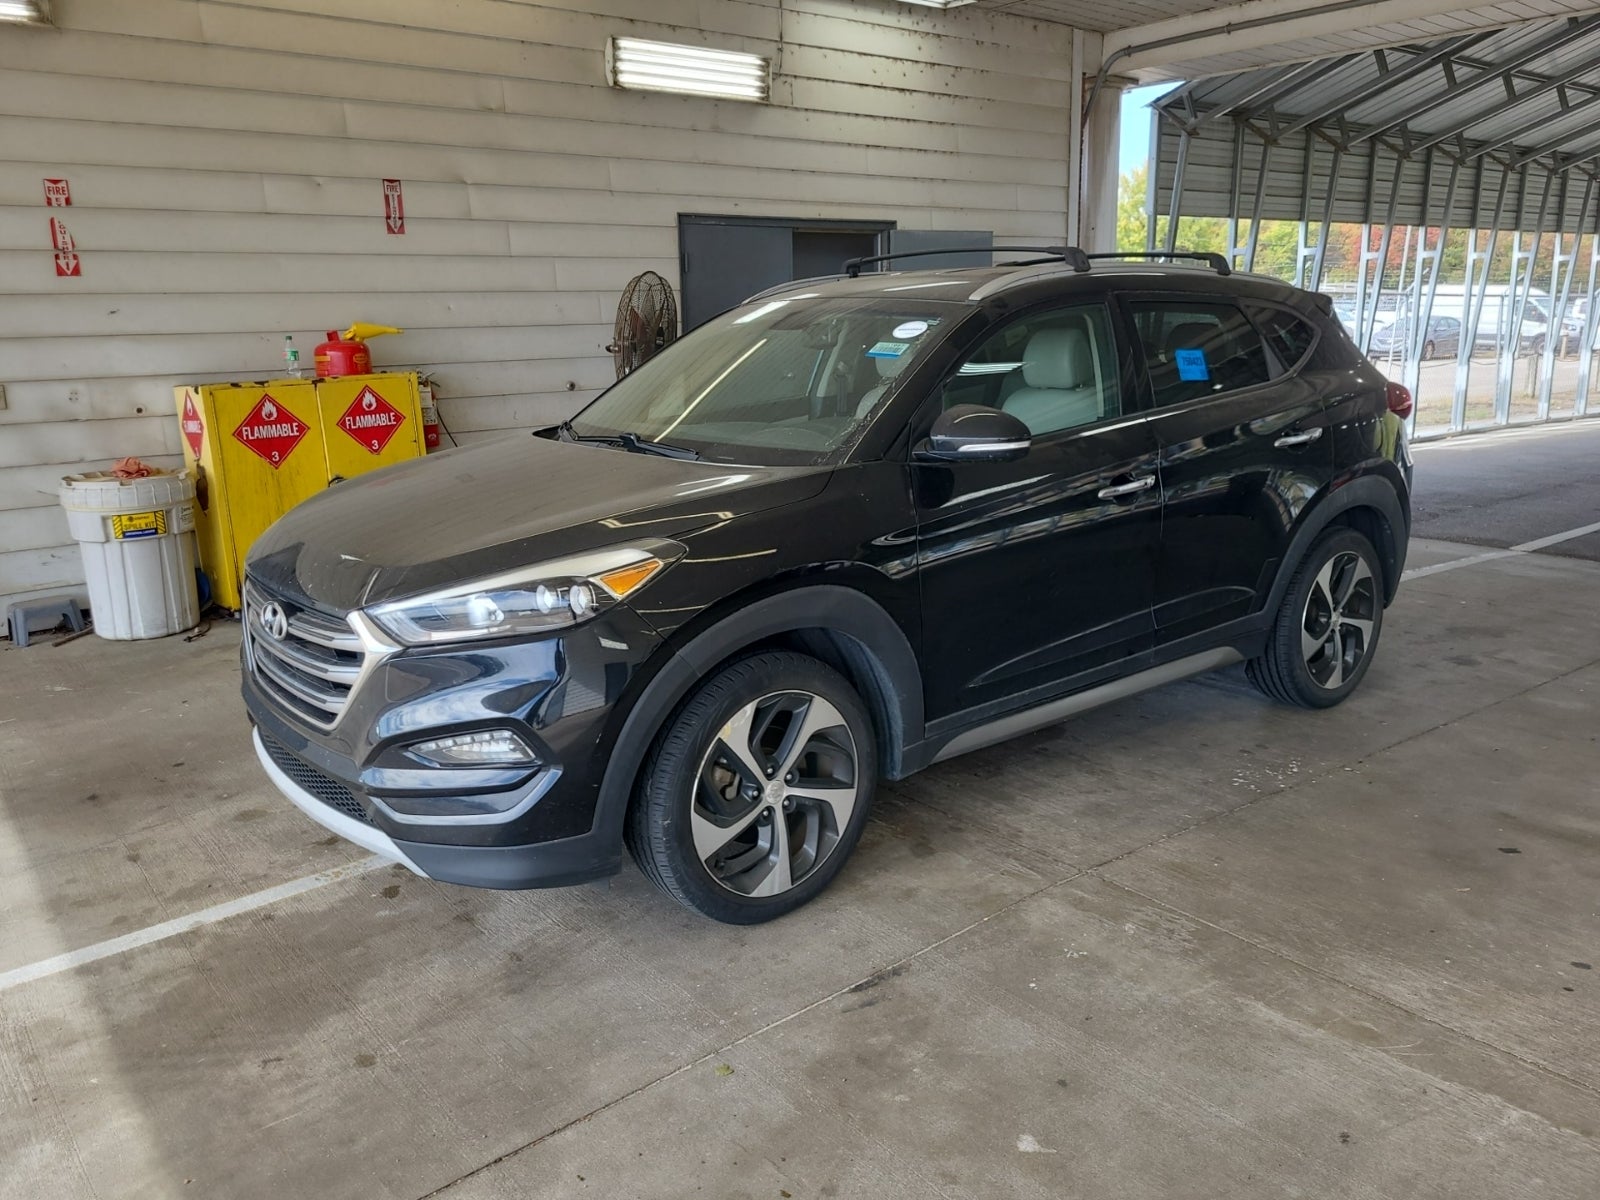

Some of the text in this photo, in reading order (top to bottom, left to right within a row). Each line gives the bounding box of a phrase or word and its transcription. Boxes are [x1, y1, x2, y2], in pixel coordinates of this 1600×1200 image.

[47, 185, 67, 196] FIRE
[345, 412, 397, 429] FLAMMABLE
[242, 422, 300, 440] FLAMMABLE
[371, 439, 379, 450] 3
[271, 451, 280, 462] 3
